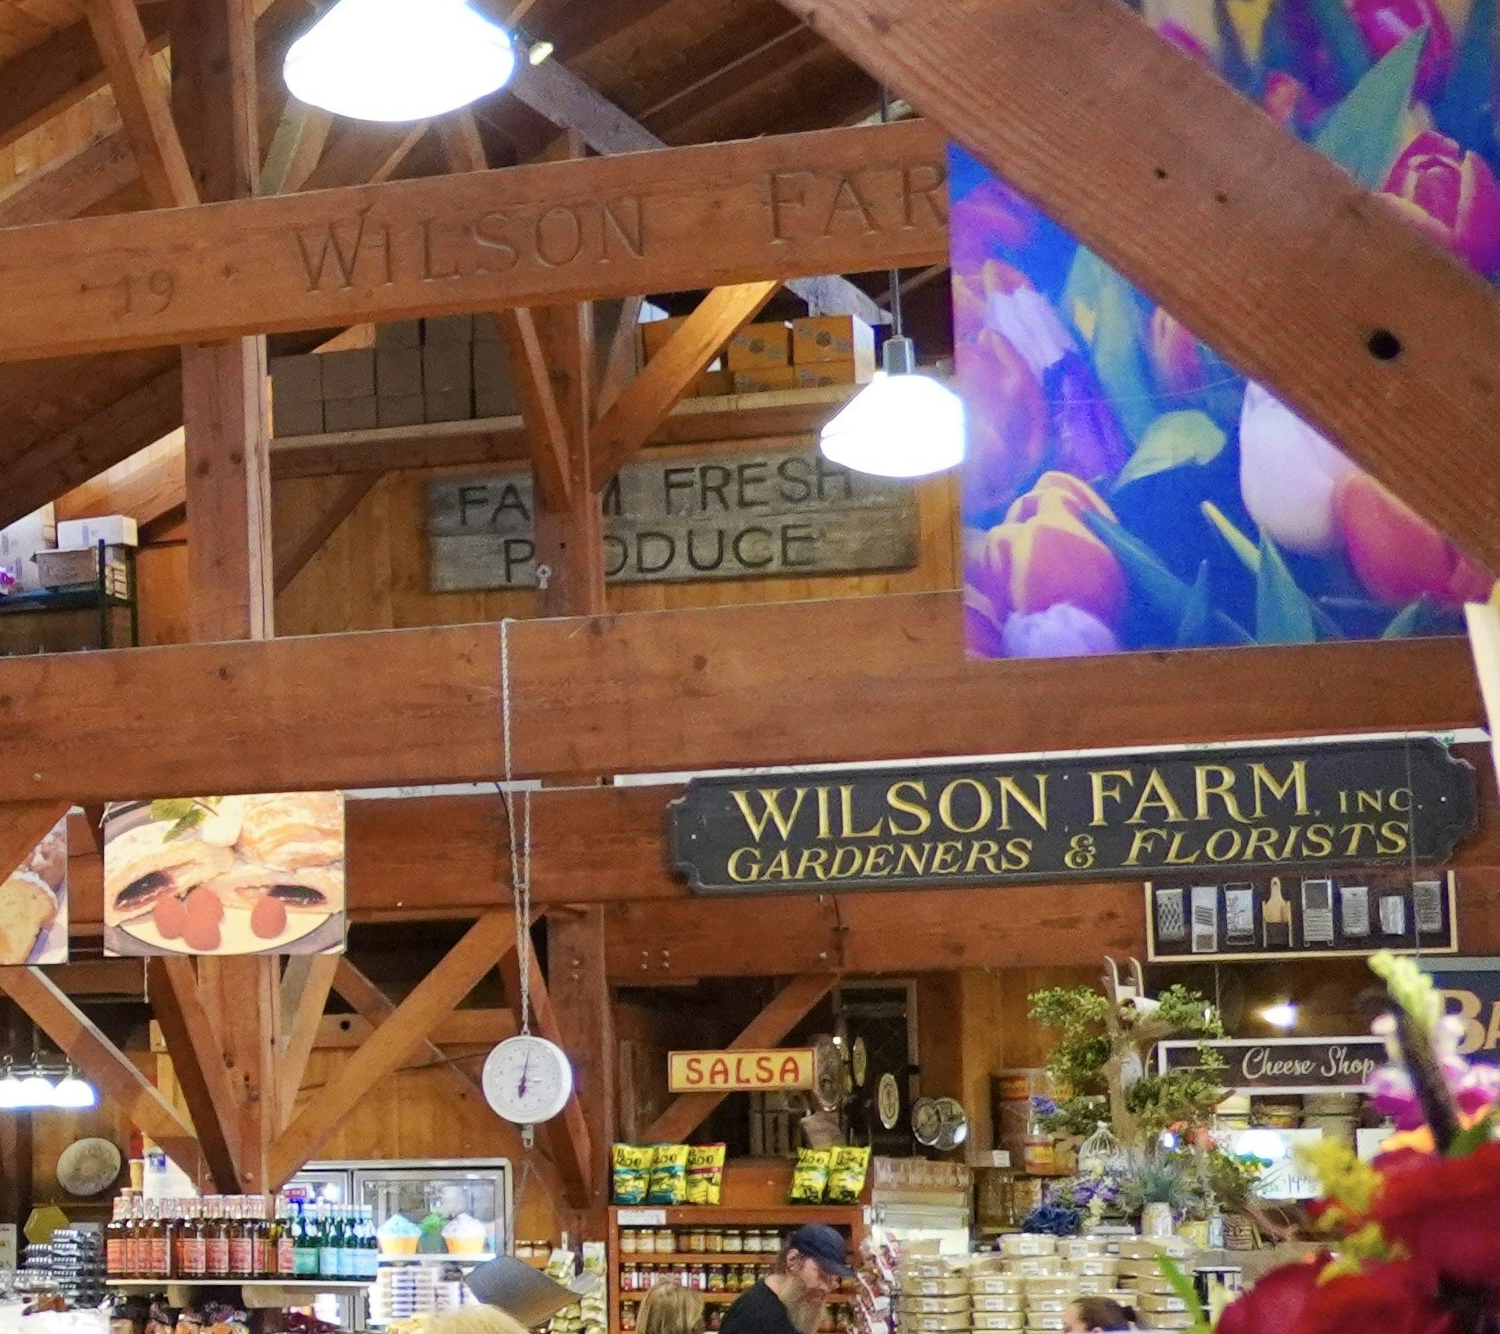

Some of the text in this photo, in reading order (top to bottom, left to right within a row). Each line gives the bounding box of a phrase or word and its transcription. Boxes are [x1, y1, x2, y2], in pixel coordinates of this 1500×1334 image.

[294, 192, 649, 294] WILSON
[763, 163, 948, 246] FAR
[459, 457, 853, 527] FAM FRESH
[503, 522, 814, 584] PODUCE
[729, 773, 1048, 843] WILSON
[727, 821, 1410, 883] GARDENERS & FLORISTS
[685, 1056, 800, 1086] SALSA
[1242, 1044, 1375, 1085] Cheese Shop
